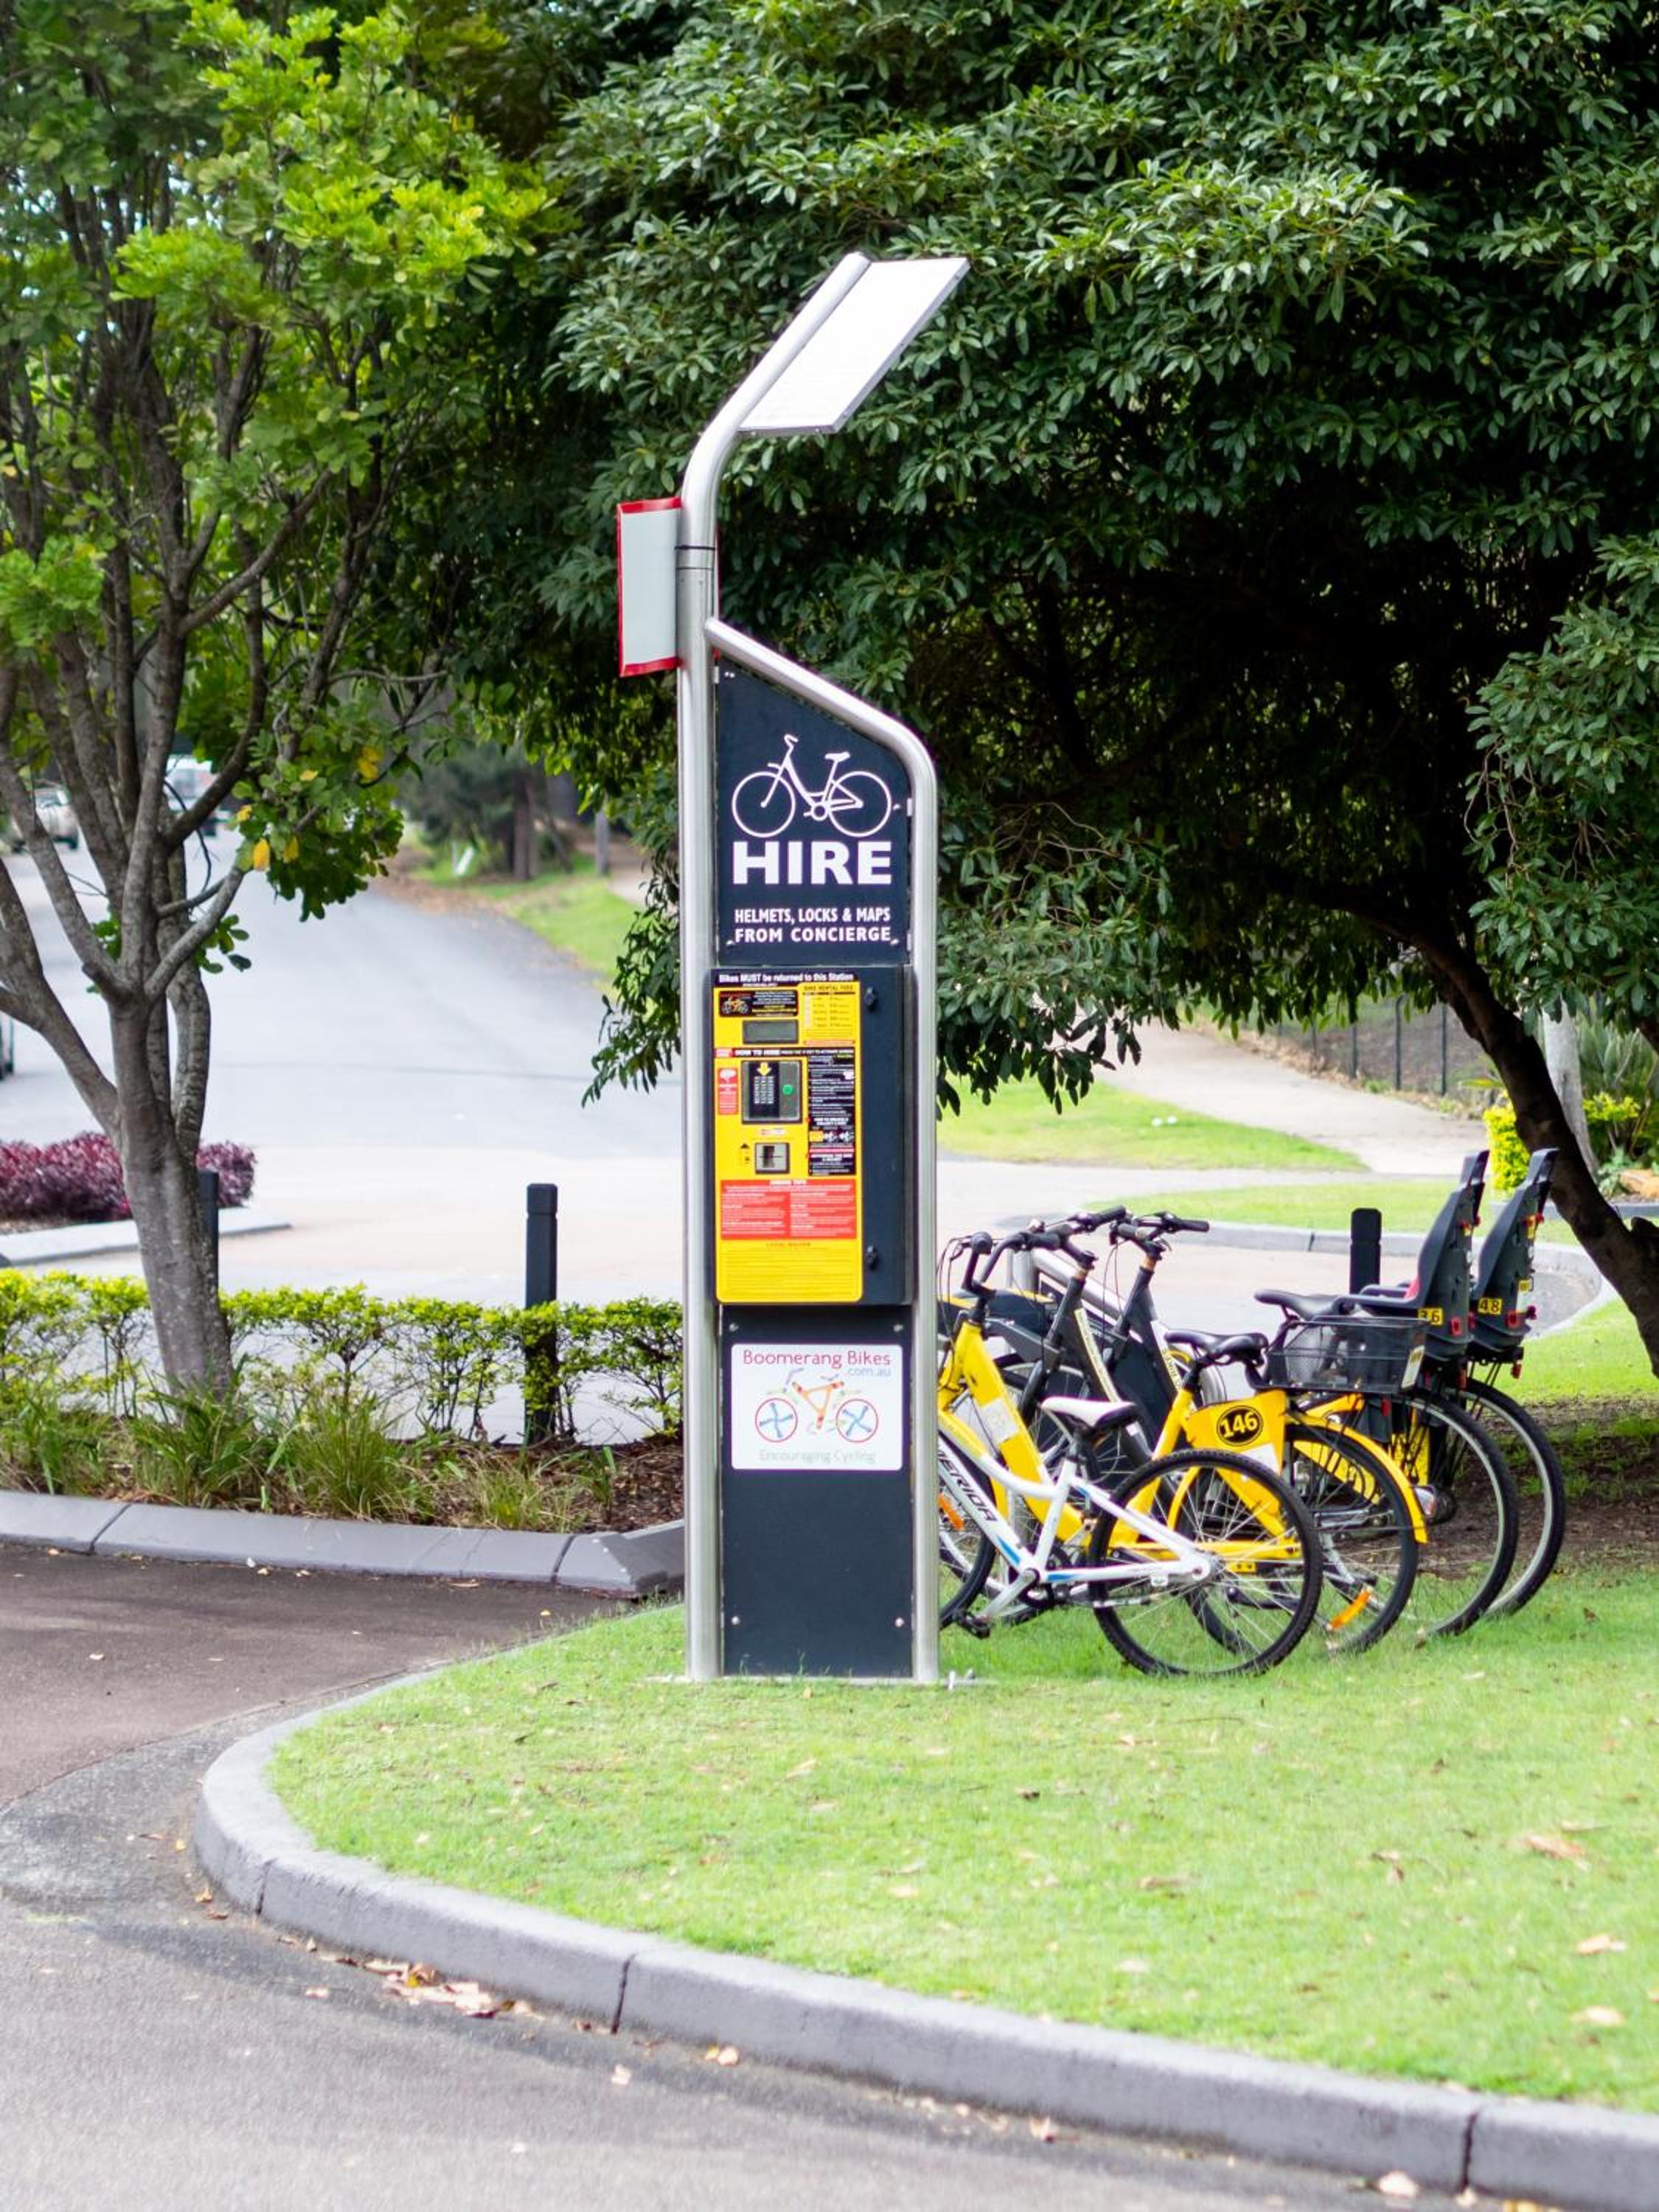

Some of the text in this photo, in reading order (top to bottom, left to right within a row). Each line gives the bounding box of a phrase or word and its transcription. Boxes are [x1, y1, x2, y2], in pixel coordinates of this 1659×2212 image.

[733, 841, 891, 884] HIRE
[735, 907, 890, 925] HELMETS, LOCKS & MAPS
[735, 927, 891, 942] FROM CONCIERGE
[740, 973, 762, 982] MUST
[762, 974, 772, 982] be
[773, 973, 802, 981] returned
[804, 973, 813, 981] to
[813, 973, 827, 981] this
[828, 973, 854, 981] Station
[1479, 1299, 1500, 1312] 48
[743, 1350, 891, 1368] Boomerang Bikes
[1219, 1413, 1258, 1439] 146
[759, 1450, 875, 1463] Encouraging Cycling
